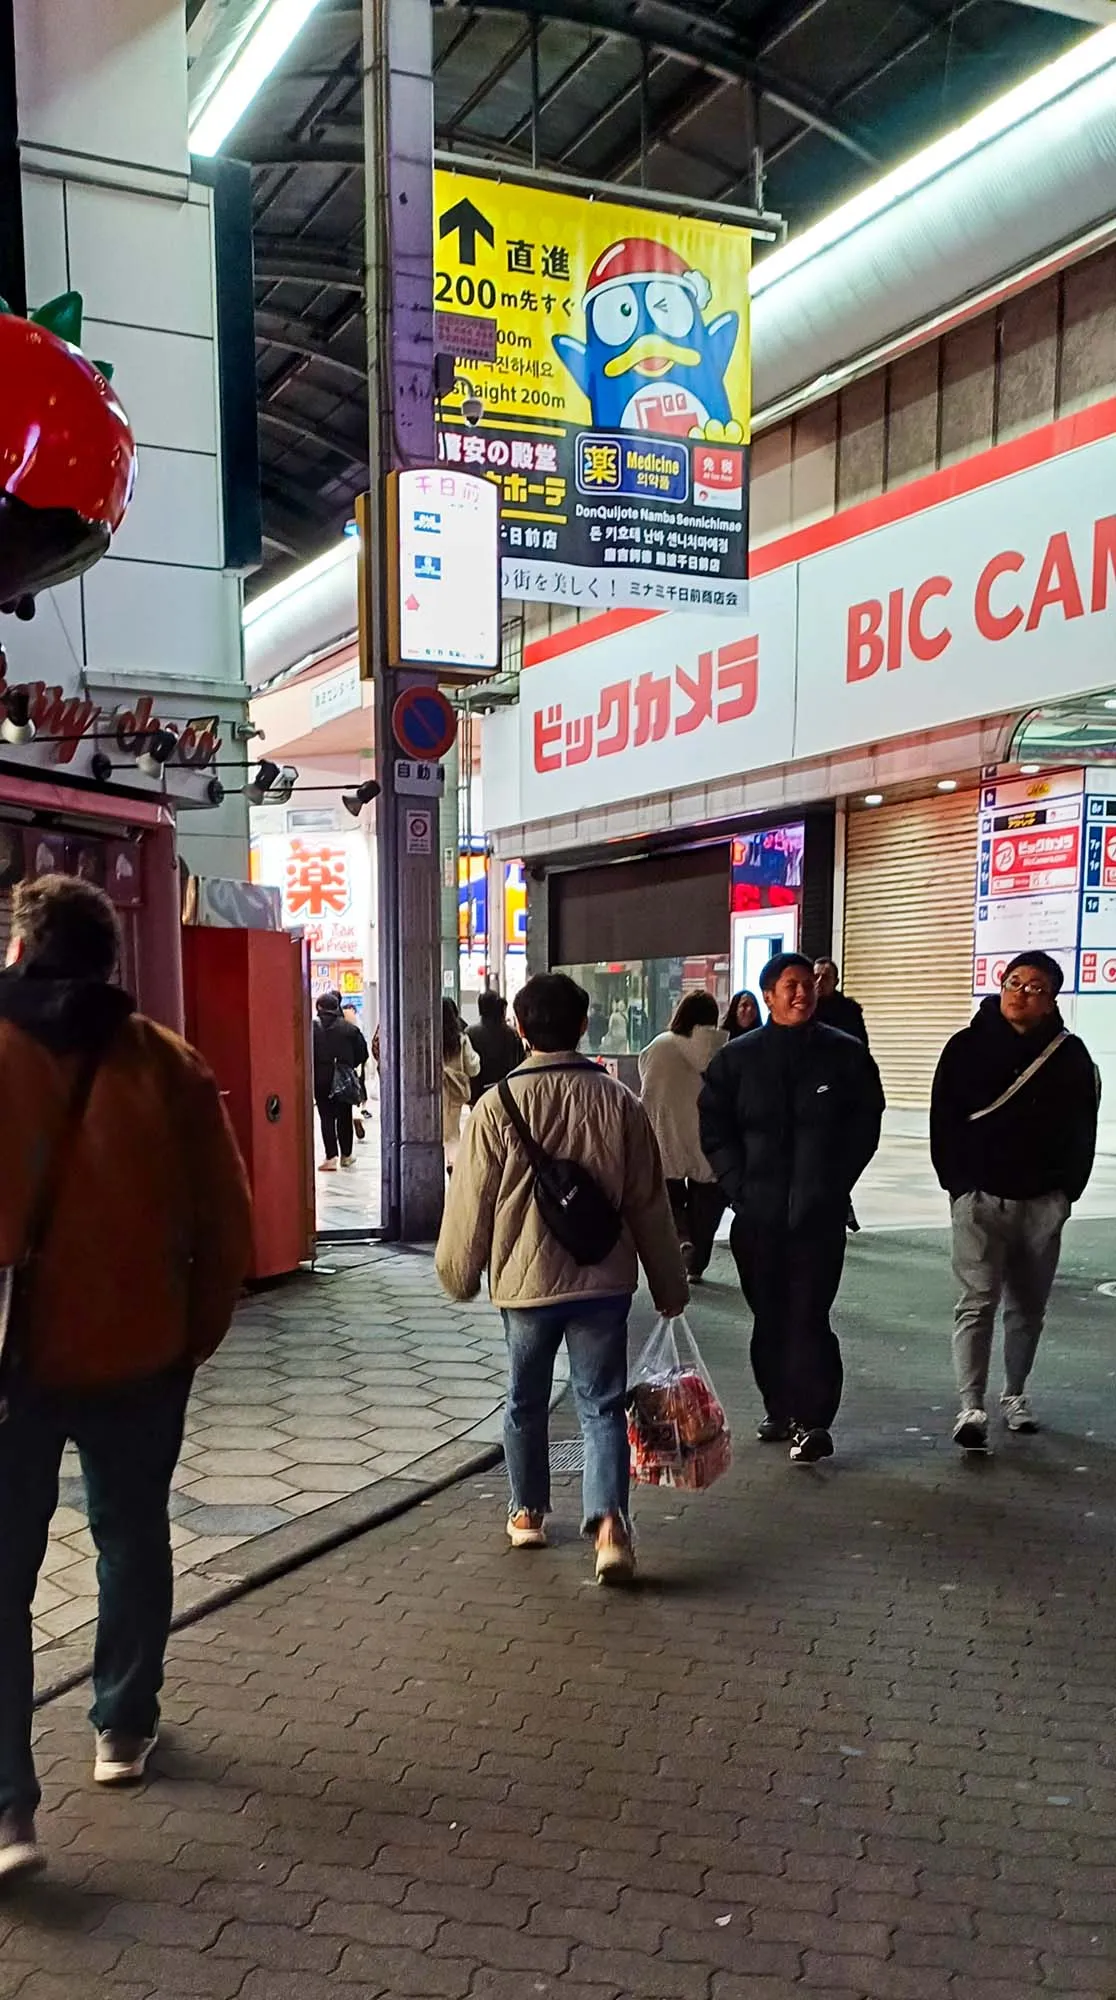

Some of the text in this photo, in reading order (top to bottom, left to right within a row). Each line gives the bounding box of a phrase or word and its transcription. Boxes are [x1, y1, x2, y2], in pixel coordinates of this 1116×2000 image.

[506, 239, 570, 281] 直進
[453, 381, 565, 409] staight 200m
[584, 446, 617, 484] 薬
[627, 451, 680, 476] Medicine
[640, 508, 676, 525] Namba
[676, 513, 742, 533] Sennichimae
[630, 581, 738, 606] ミナミ千日前商店会
[846, 574, 952, 684] BIC
[533, 633, 760, 775] ビックカメラ
[286, 843, 348, 915] 薬
